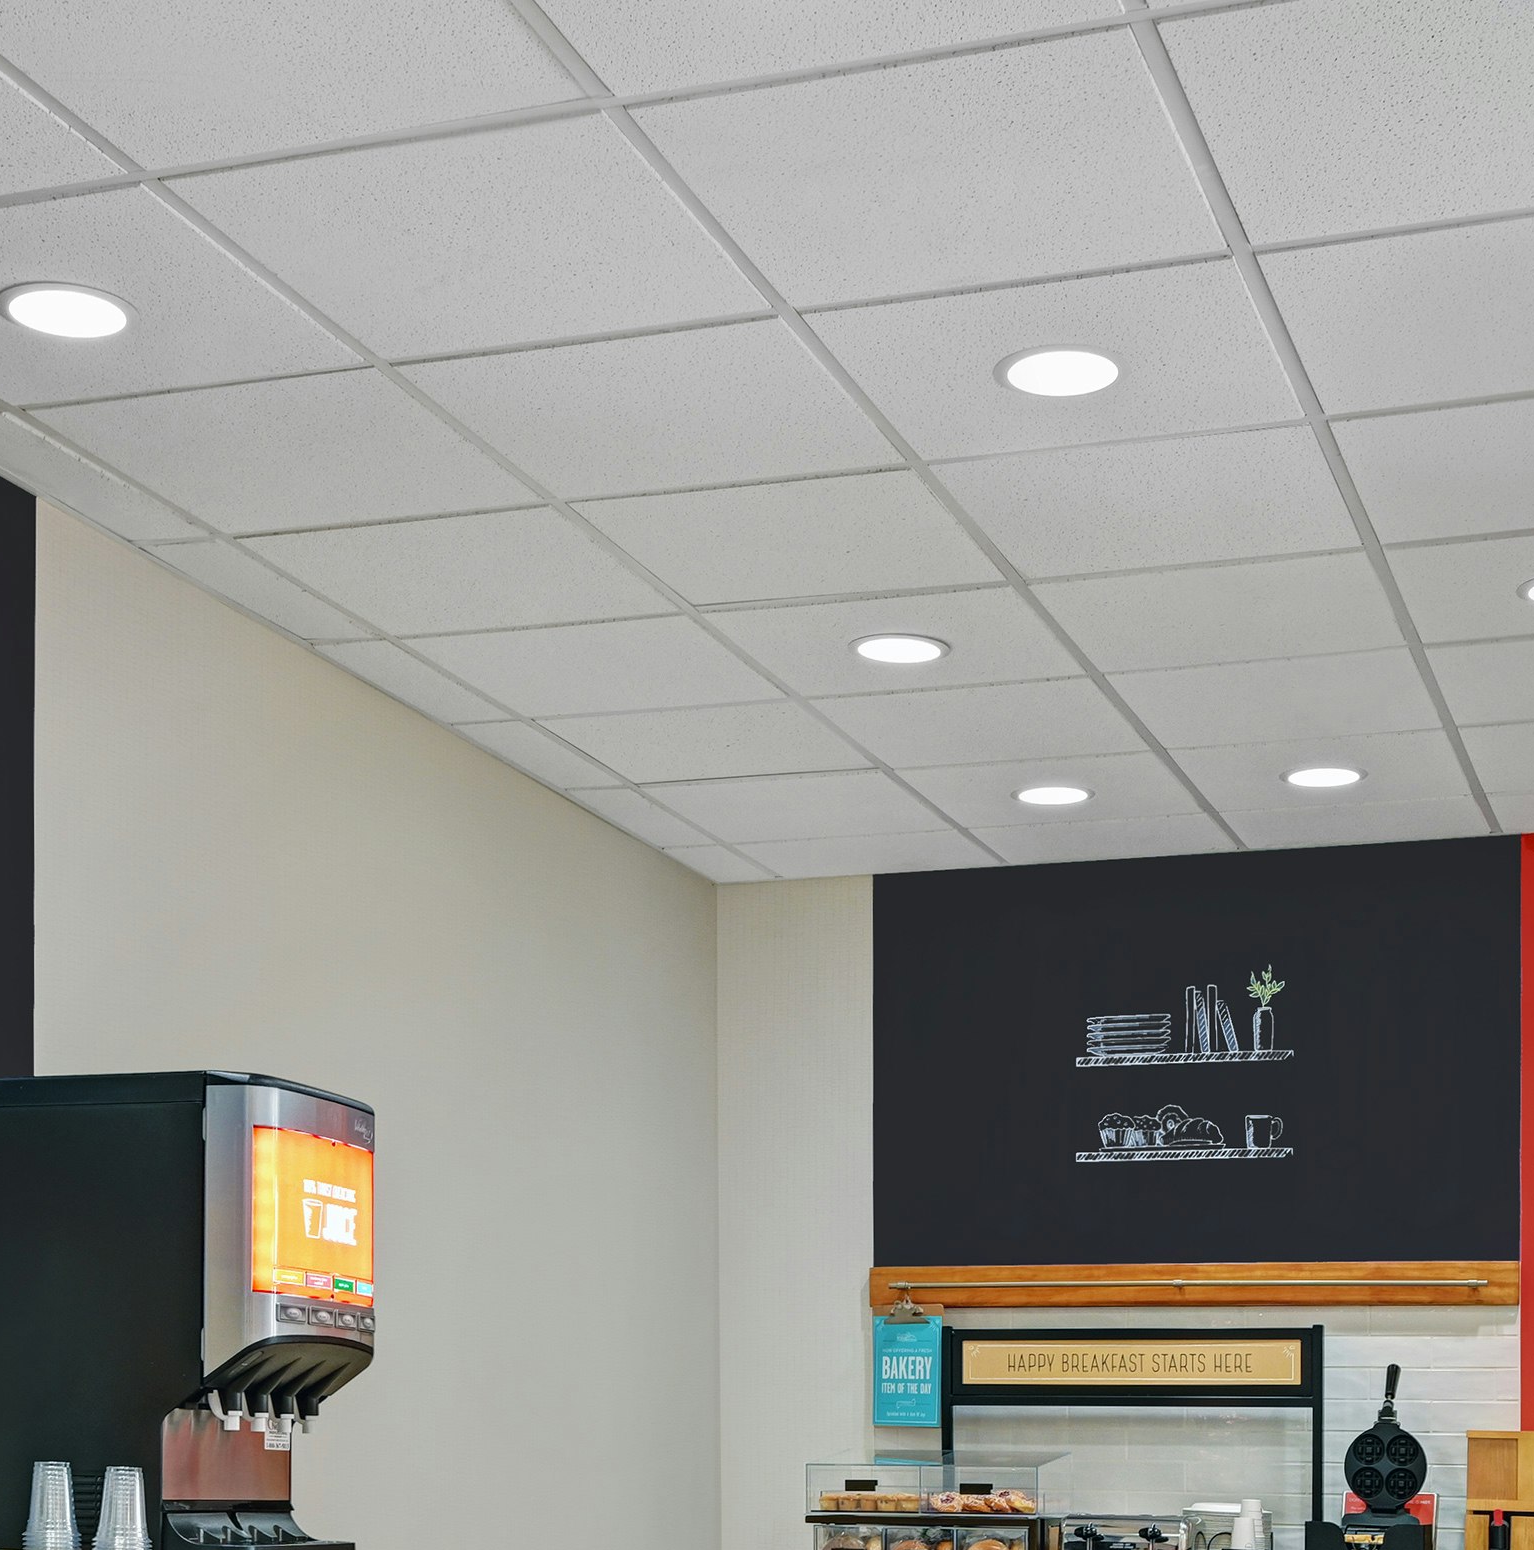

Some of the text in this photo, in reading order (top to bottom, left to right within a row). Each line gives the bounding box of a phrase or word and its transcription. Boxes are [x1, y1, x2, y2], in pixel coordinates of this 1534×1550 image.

[882, 1356, 932, 1380] BAKERY
[1007, 1353, 1253, 1373] HAPPY BREAKFAST STARTS HERE
[881, 1383, 932, 1394] ITEM OF THE DAY
